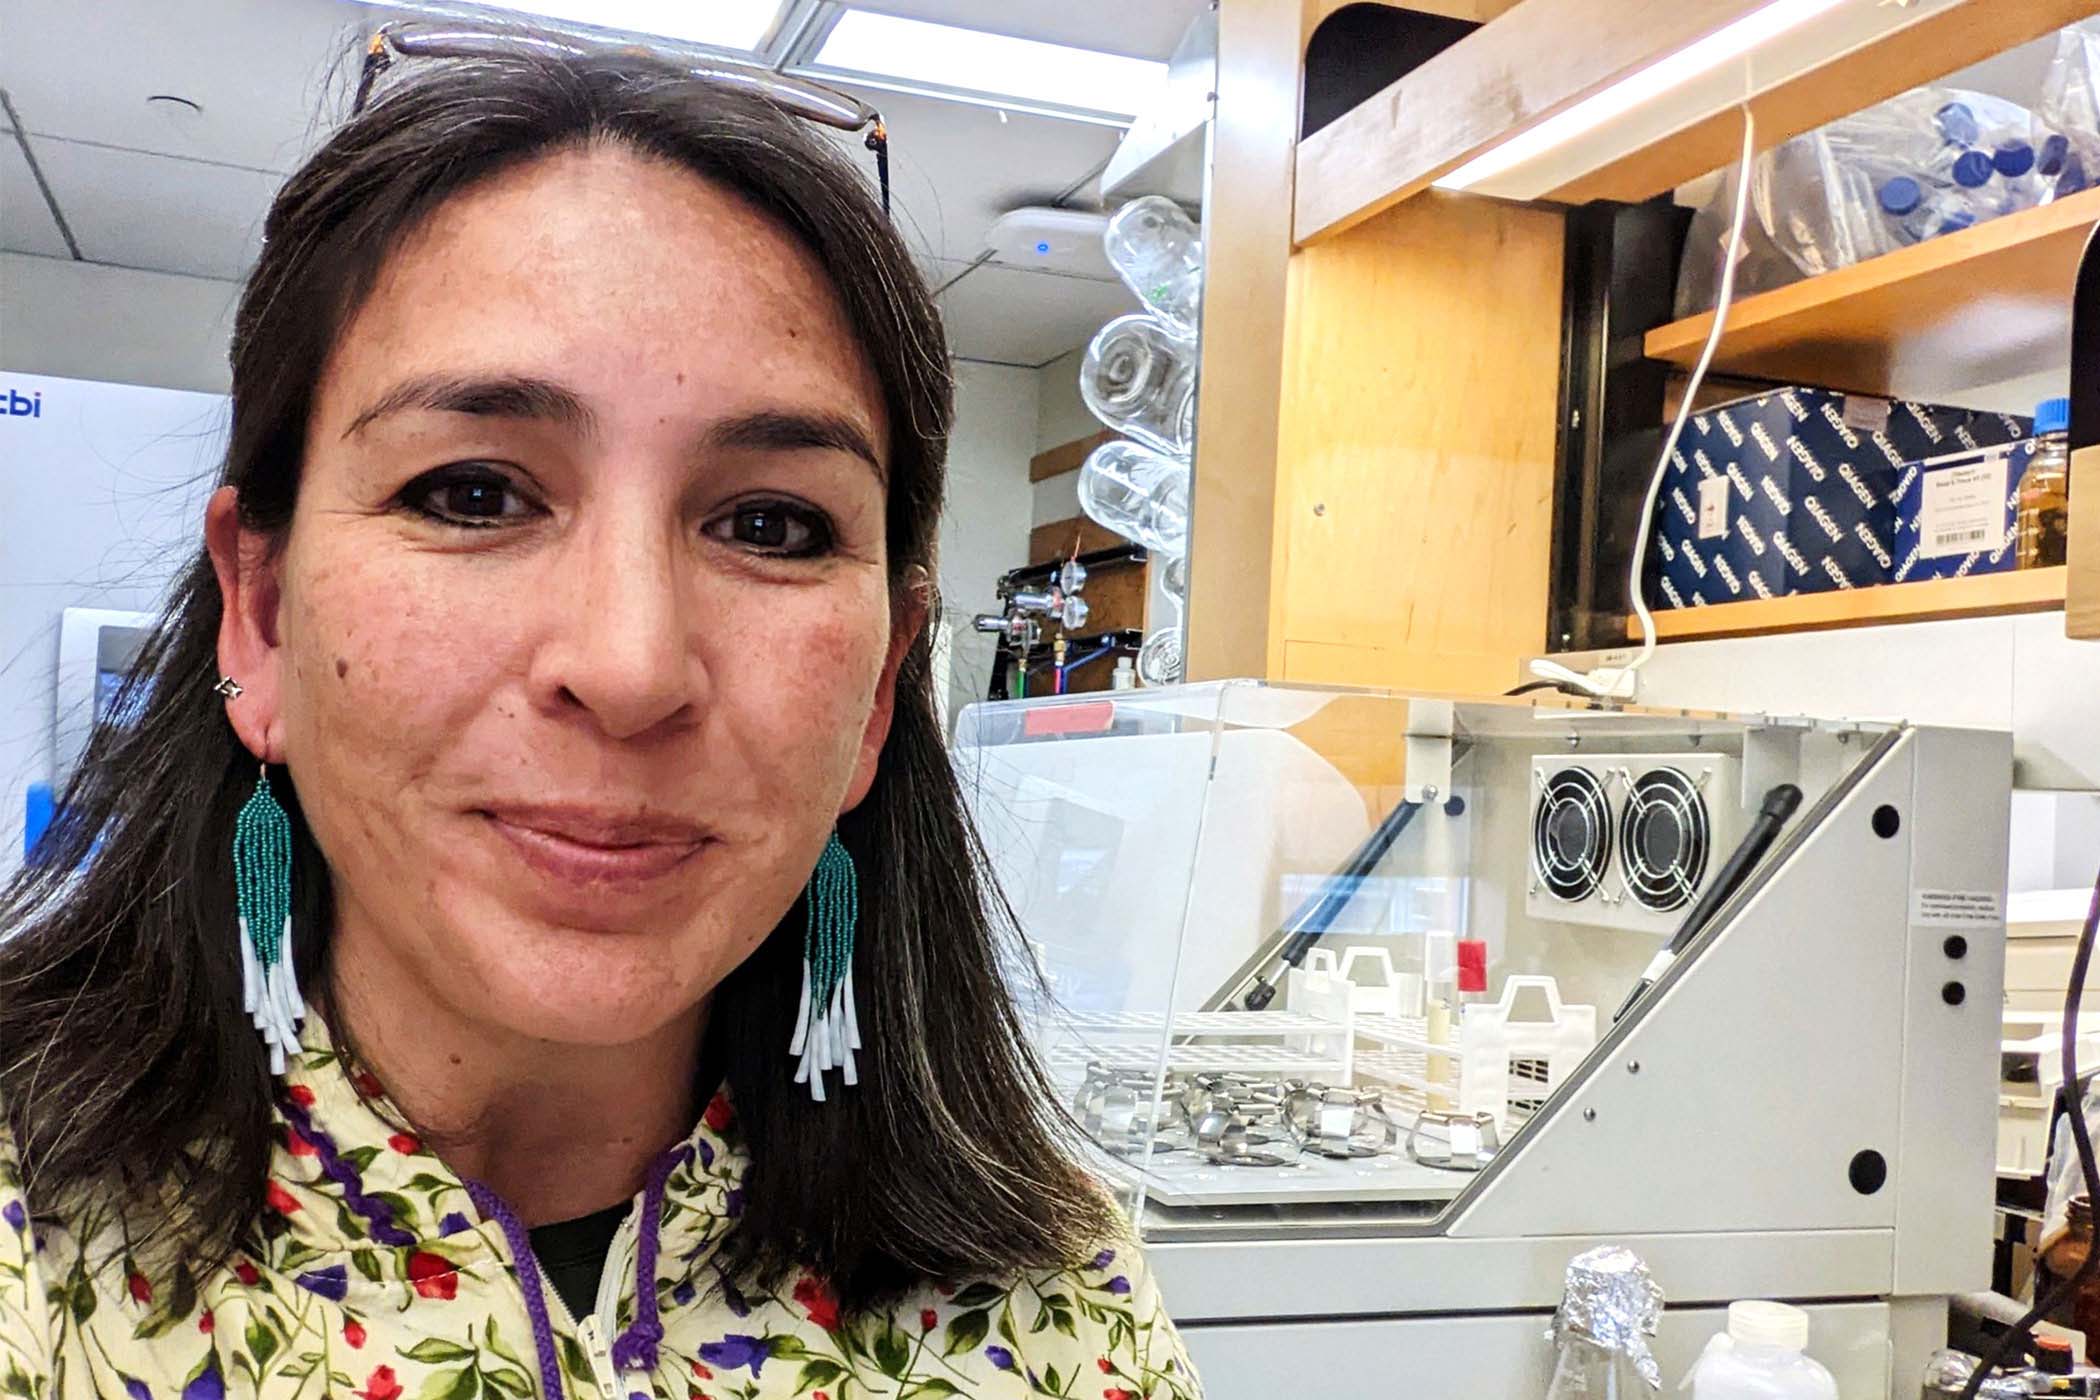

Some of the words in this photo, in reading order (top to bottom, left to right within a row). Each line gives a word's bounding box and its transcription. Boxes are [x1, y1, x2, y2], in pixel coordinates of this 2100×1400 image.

[1751, 422, 1778, 461] QIAGEN
[1821, 402, 1858, 449] QIAGEN
[1954, 424, 1978, 450] GEN
[1786, 435, 1824, 481] QIAGEN
[1872, 430, 1903, 471] QIAGE
[1727, 462, 1754, 500] QIAGEN
[1761, 475, 1791, 516] QIAGEN
[1839, 463, 1877, 510] QIAGEN
[1736, 515, 1765, 556] QIAGEN
[1804, 495, 1844, 543] QIAGEN
[1682, 540, 1707, 578] QIAGEN
[1773, 531, 1811, 576] QIAGEN
[1855, 521, 1891, 569] QIAGEN
[1714, 553, 1740, 594] QIAGEN
